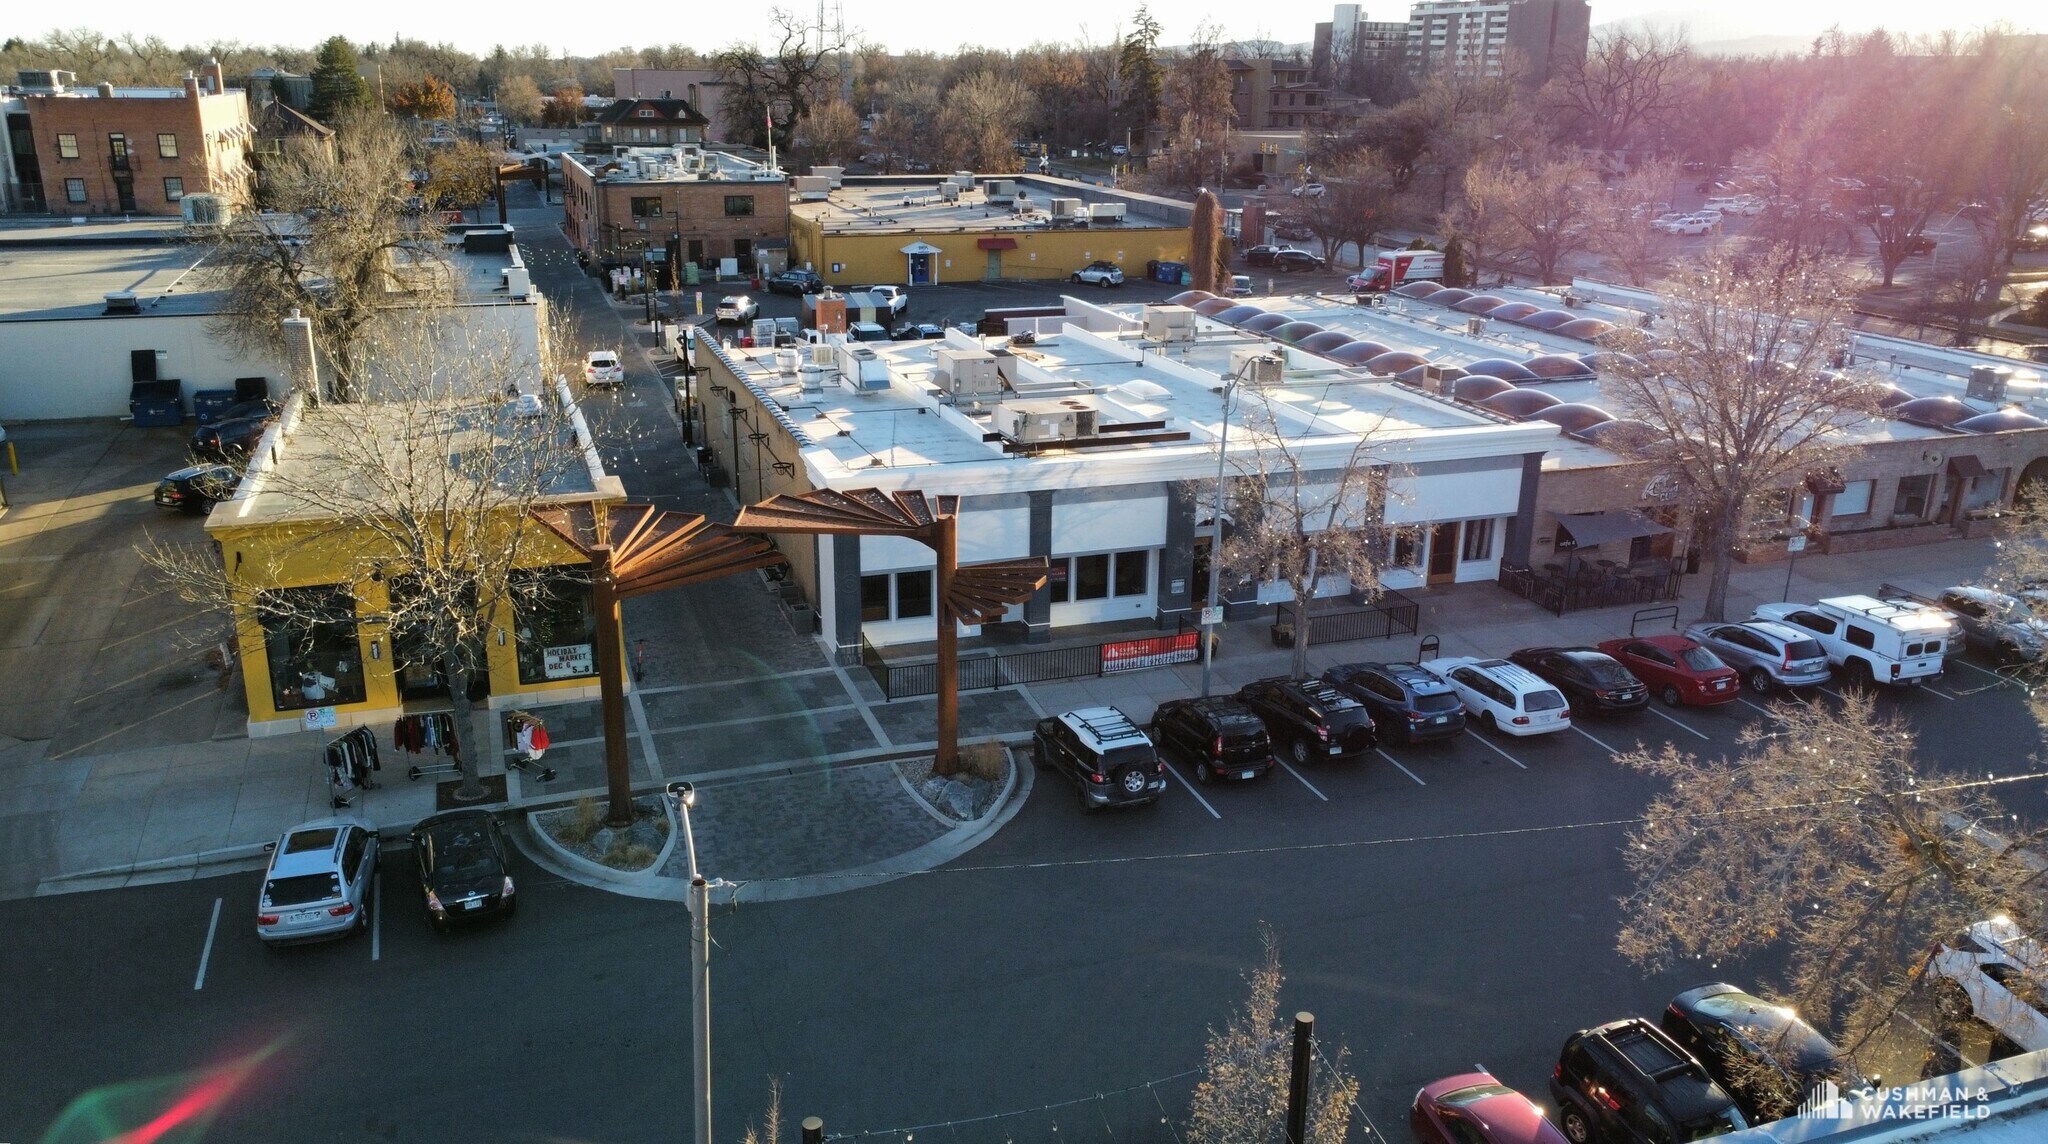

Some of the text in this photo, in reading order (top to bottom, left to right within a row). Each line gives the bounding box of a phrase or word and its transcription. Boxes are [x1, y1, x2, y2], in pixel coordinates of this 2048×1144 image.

[547, 647, 577, 656] HOLIDAY
[558, 653, 586, 662] MARKET
[548, 662, 563, 670] DEC
